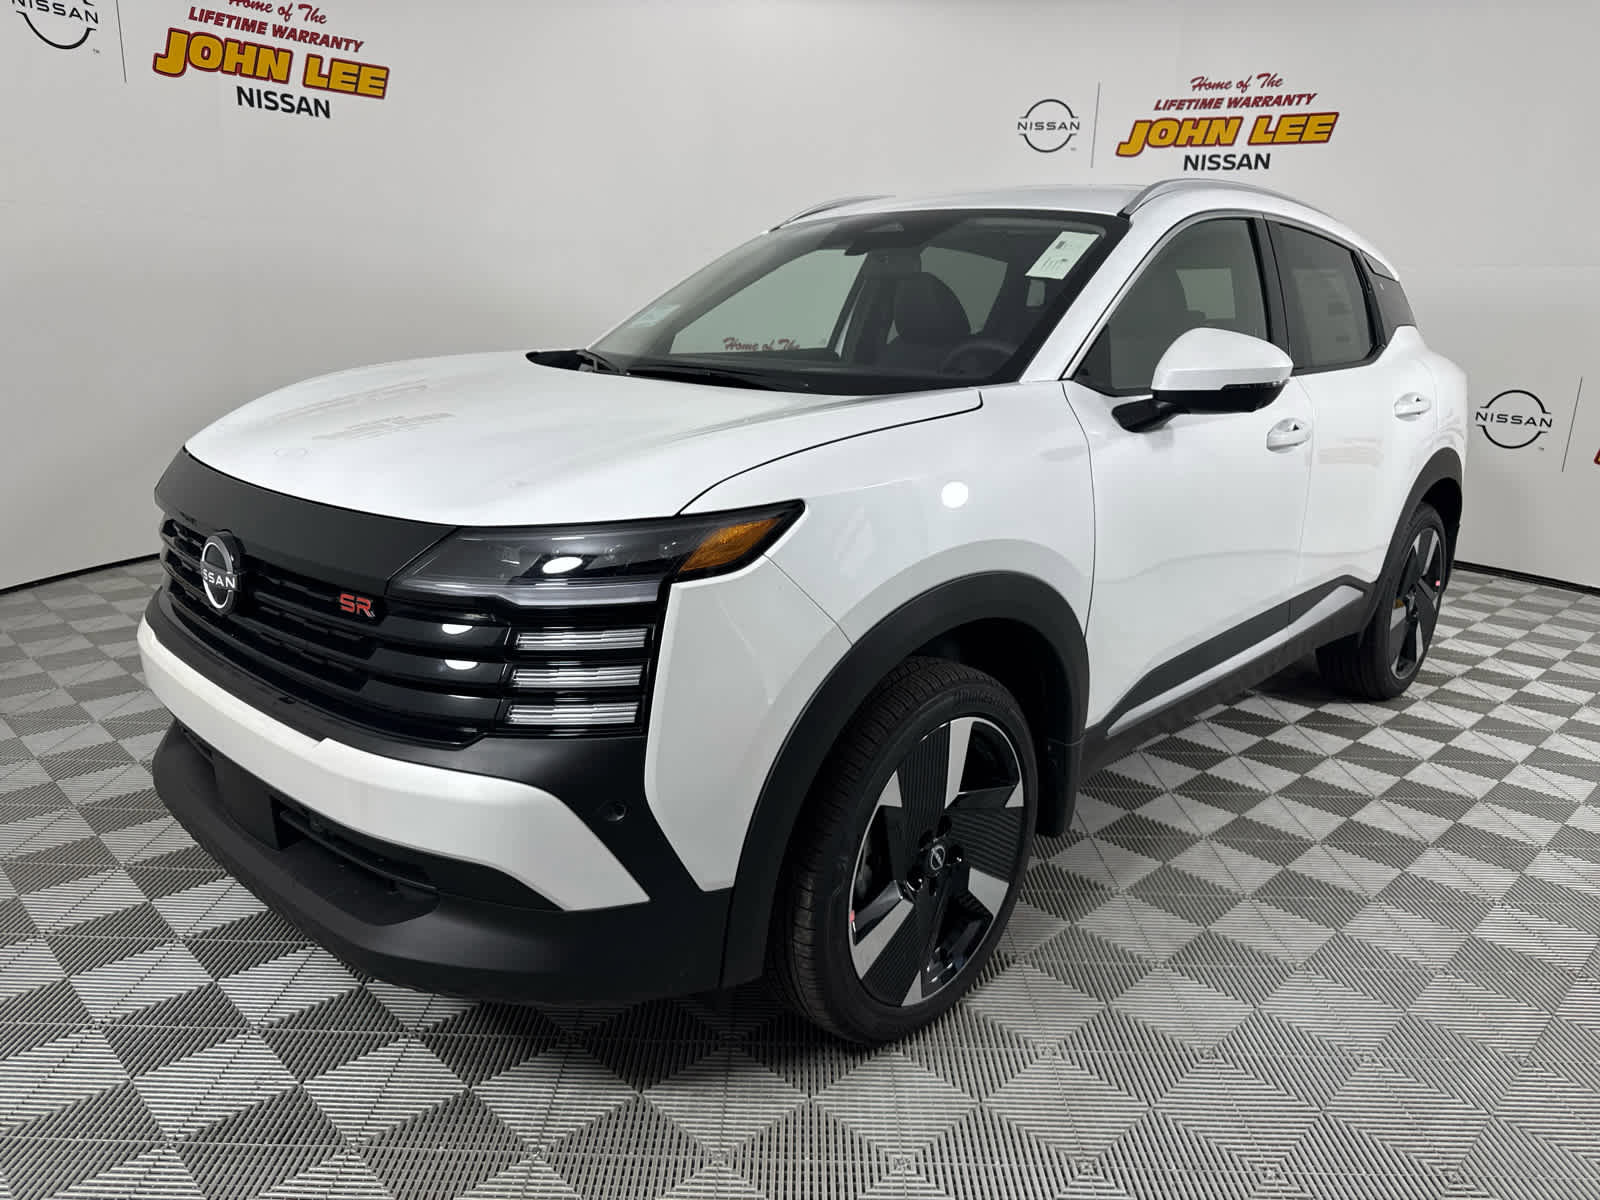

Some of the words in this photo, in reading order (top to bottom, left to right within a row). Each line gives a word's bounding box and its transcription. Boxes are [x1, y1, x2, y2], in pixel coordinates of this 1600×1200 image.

[277, 2, 293, 22] of
[297, 3, 328, 24] The
[188, 6, 268, 35] LIFETIME
[271, 23, 364, 53] WARRANTY
[153, 27, 293, 85] JOHN
[303, 53, 390, 100] LEE
[1190, 76, 1232, 92] Home
[1236, 75, 1252, 93] of
[1256, 72, 1283, 88] The
[236, 86, 331, 119] NISSAN
[1153, 97, 1225, 111] LIFETIME
[1226, 93, 1317, 109] WARRANTY
[1017, 121, 1080, 130] NISSAN
[1116, 116, 1243, 157] JOHN
[1248, 112, 1339, 145] LEE
[1183, 153, 1271, 171] NISSAN
[1475, 411, 1553, 428] NISSAN
[340, 593, 376, 617] SR
